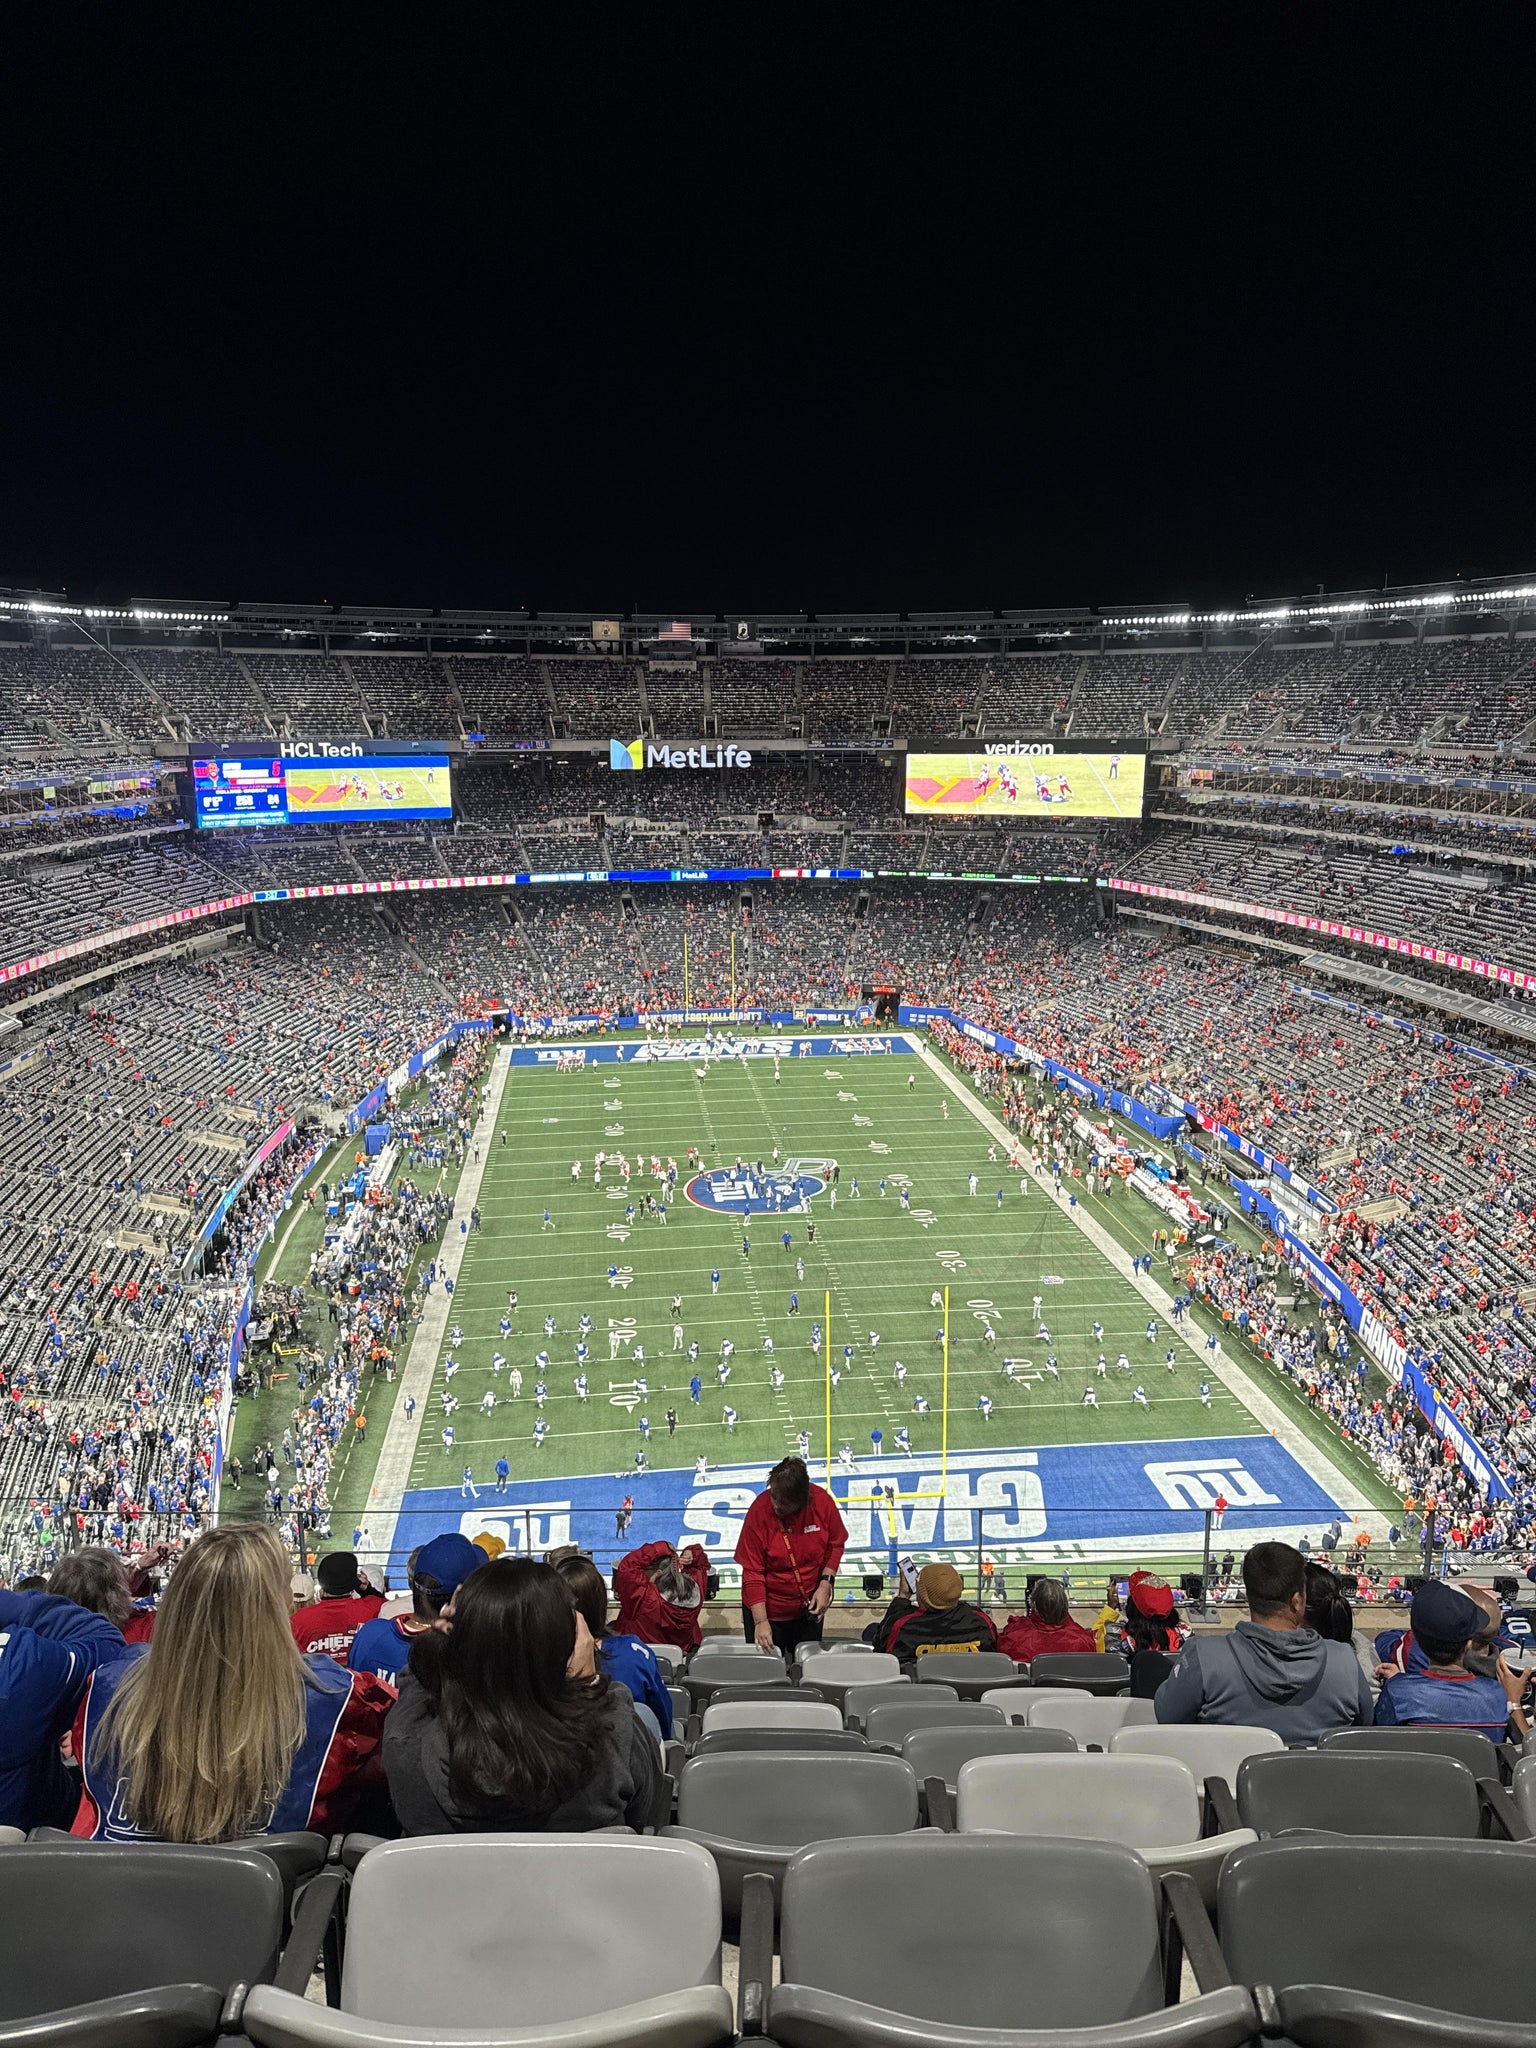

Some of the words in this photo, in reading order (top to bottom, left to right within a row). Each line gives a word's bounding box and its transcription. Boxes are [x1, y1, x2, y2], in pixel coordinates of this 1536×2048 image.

[280, 742, 363, 758] HCLTech
[647, 744, 752, 768] MetLife
[984, 740, 1055, 756] verizon
[272, 761, 281, 777] 5
[1322, 959, 1347, 970] MetLife
[1403, 982, 1427, 994] MetLife
[635, 1040, 793, 1056] GIANTS
[887, 1174, 914, 1187] 50
[606, 1185, 629, 1199] 50
[909, 1209, 938, 1225] 40
[606, 1223, 631, 1239] 40
[935, 1250, 967, 1268] 30
[966, 1299, 1002, 1319] 20
[608, 1318, 637, 1339] 20
[1358, 1308, 1408, 1382] GIANTS
[1003, 1358, 1044, 1384] 10
[608, 1380, 641, 1406] 10
[1144, 1458, 1283, 1510] ny
[678, 1470, 1047, 1552] GIANS
[911, 1548, 1034, 1565] TAKES
[1053, 1544, 1087, 1559] IT
[837, 1556, 888, 1572] AL
[306, 1635, 354, 1653] CHIEF
